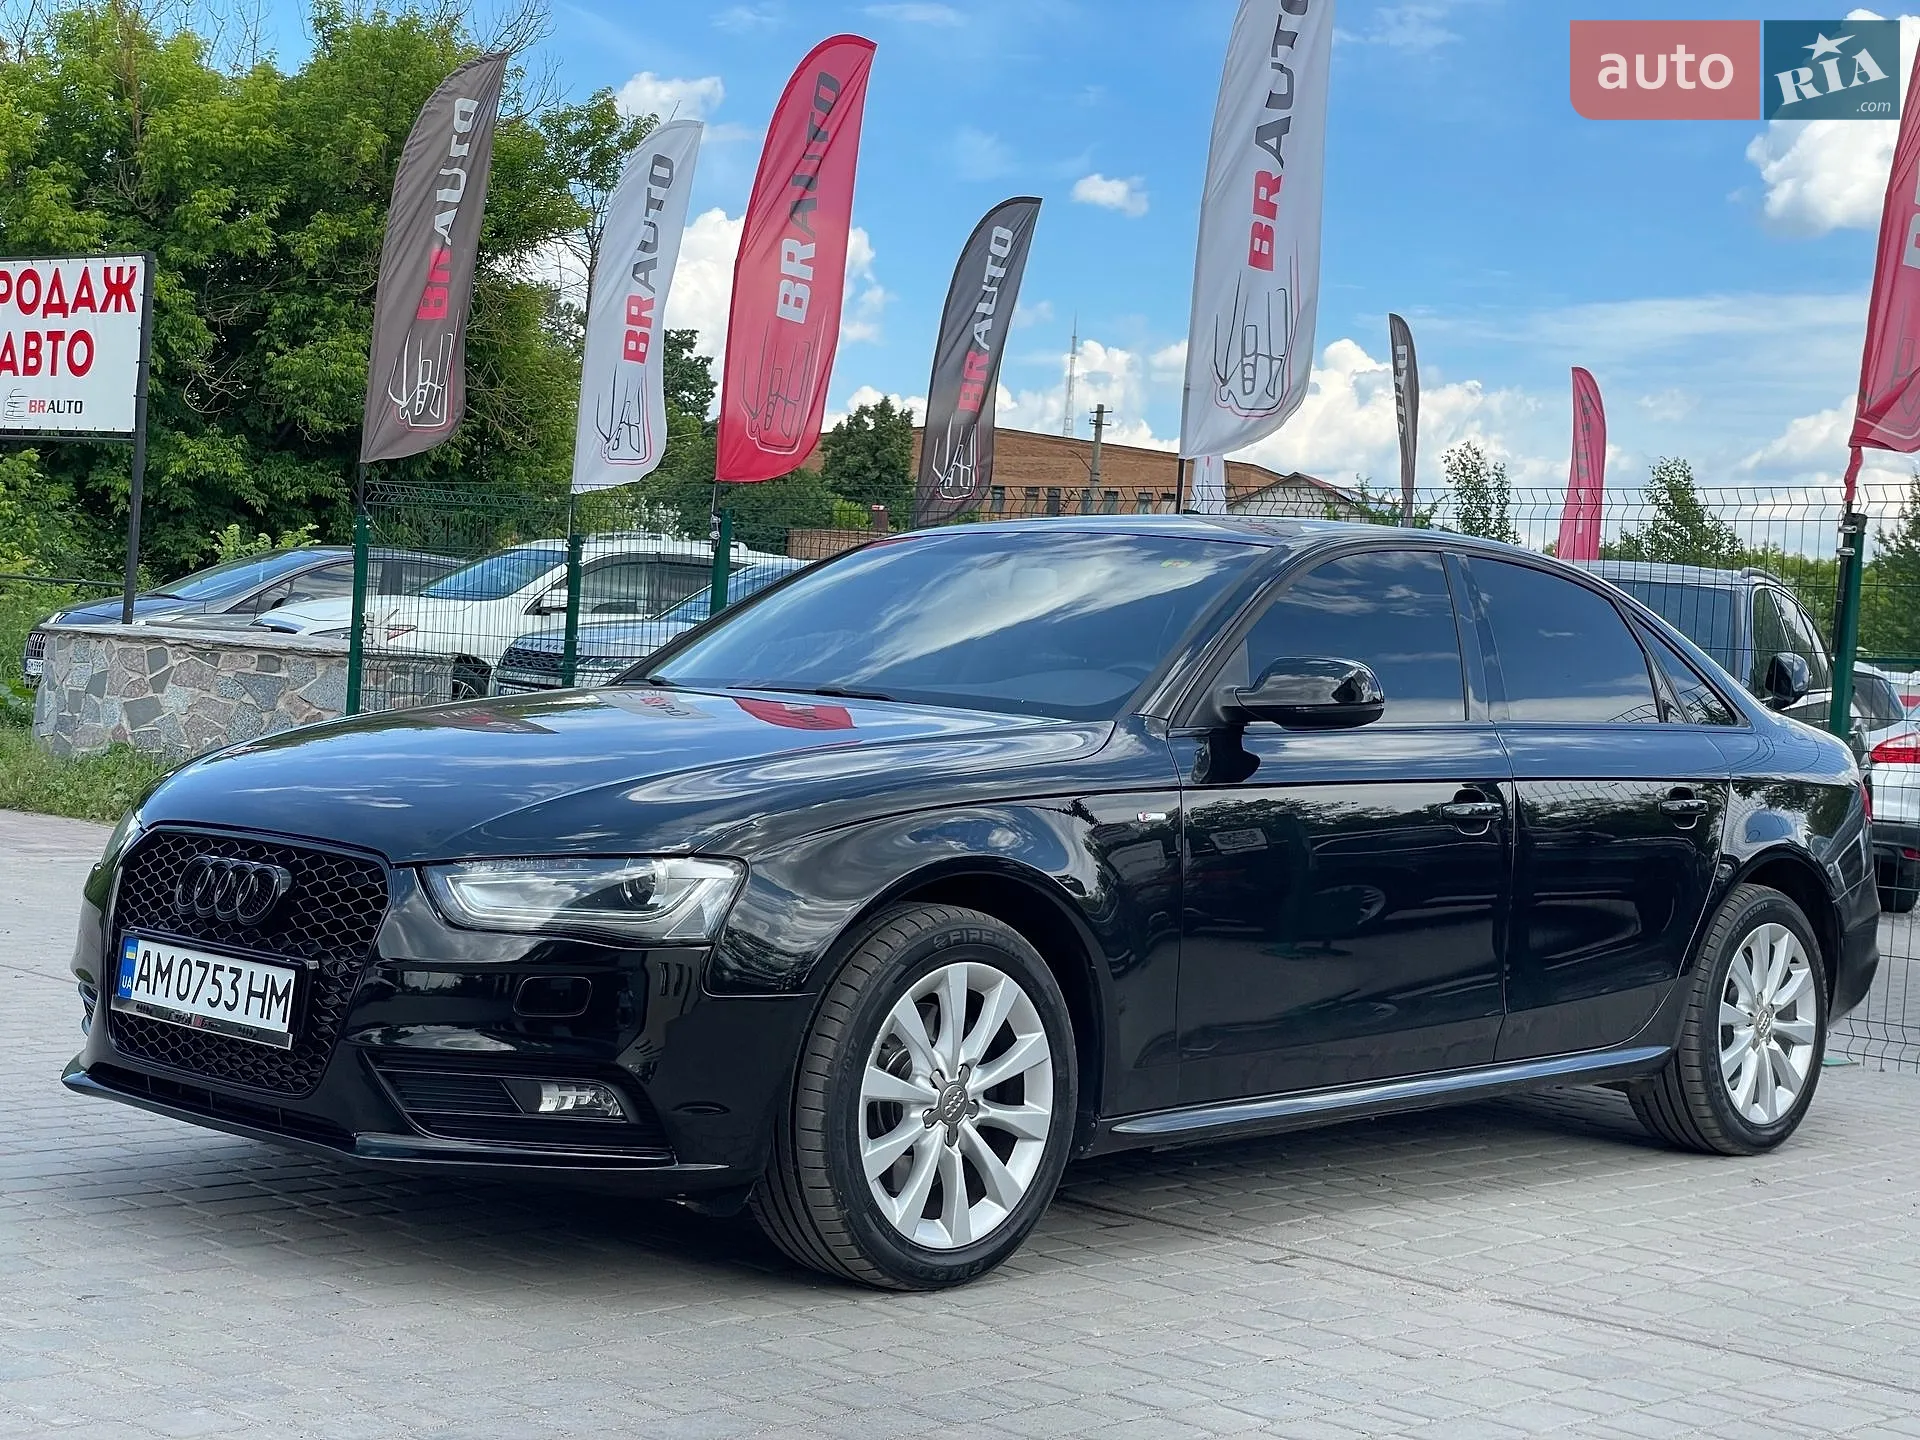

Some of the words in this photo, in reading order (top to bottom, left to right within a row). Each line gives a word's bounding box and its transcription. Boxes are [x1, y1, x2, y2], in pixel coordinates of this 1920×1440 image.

[416, 98, 479, 320] BRAUTO
[622, 153, 675, 365] BRAUTO
[776, 71, 841, 325] BRAUTO
[0, 329, 95, 378] АВТО
[958, 225, 1014, 414] BRAUTO
[28, 399, 84, 414] BRAUTO
[121, 975, 132, 989] UA
[134, 950, 293, 1024] AM0753HM
